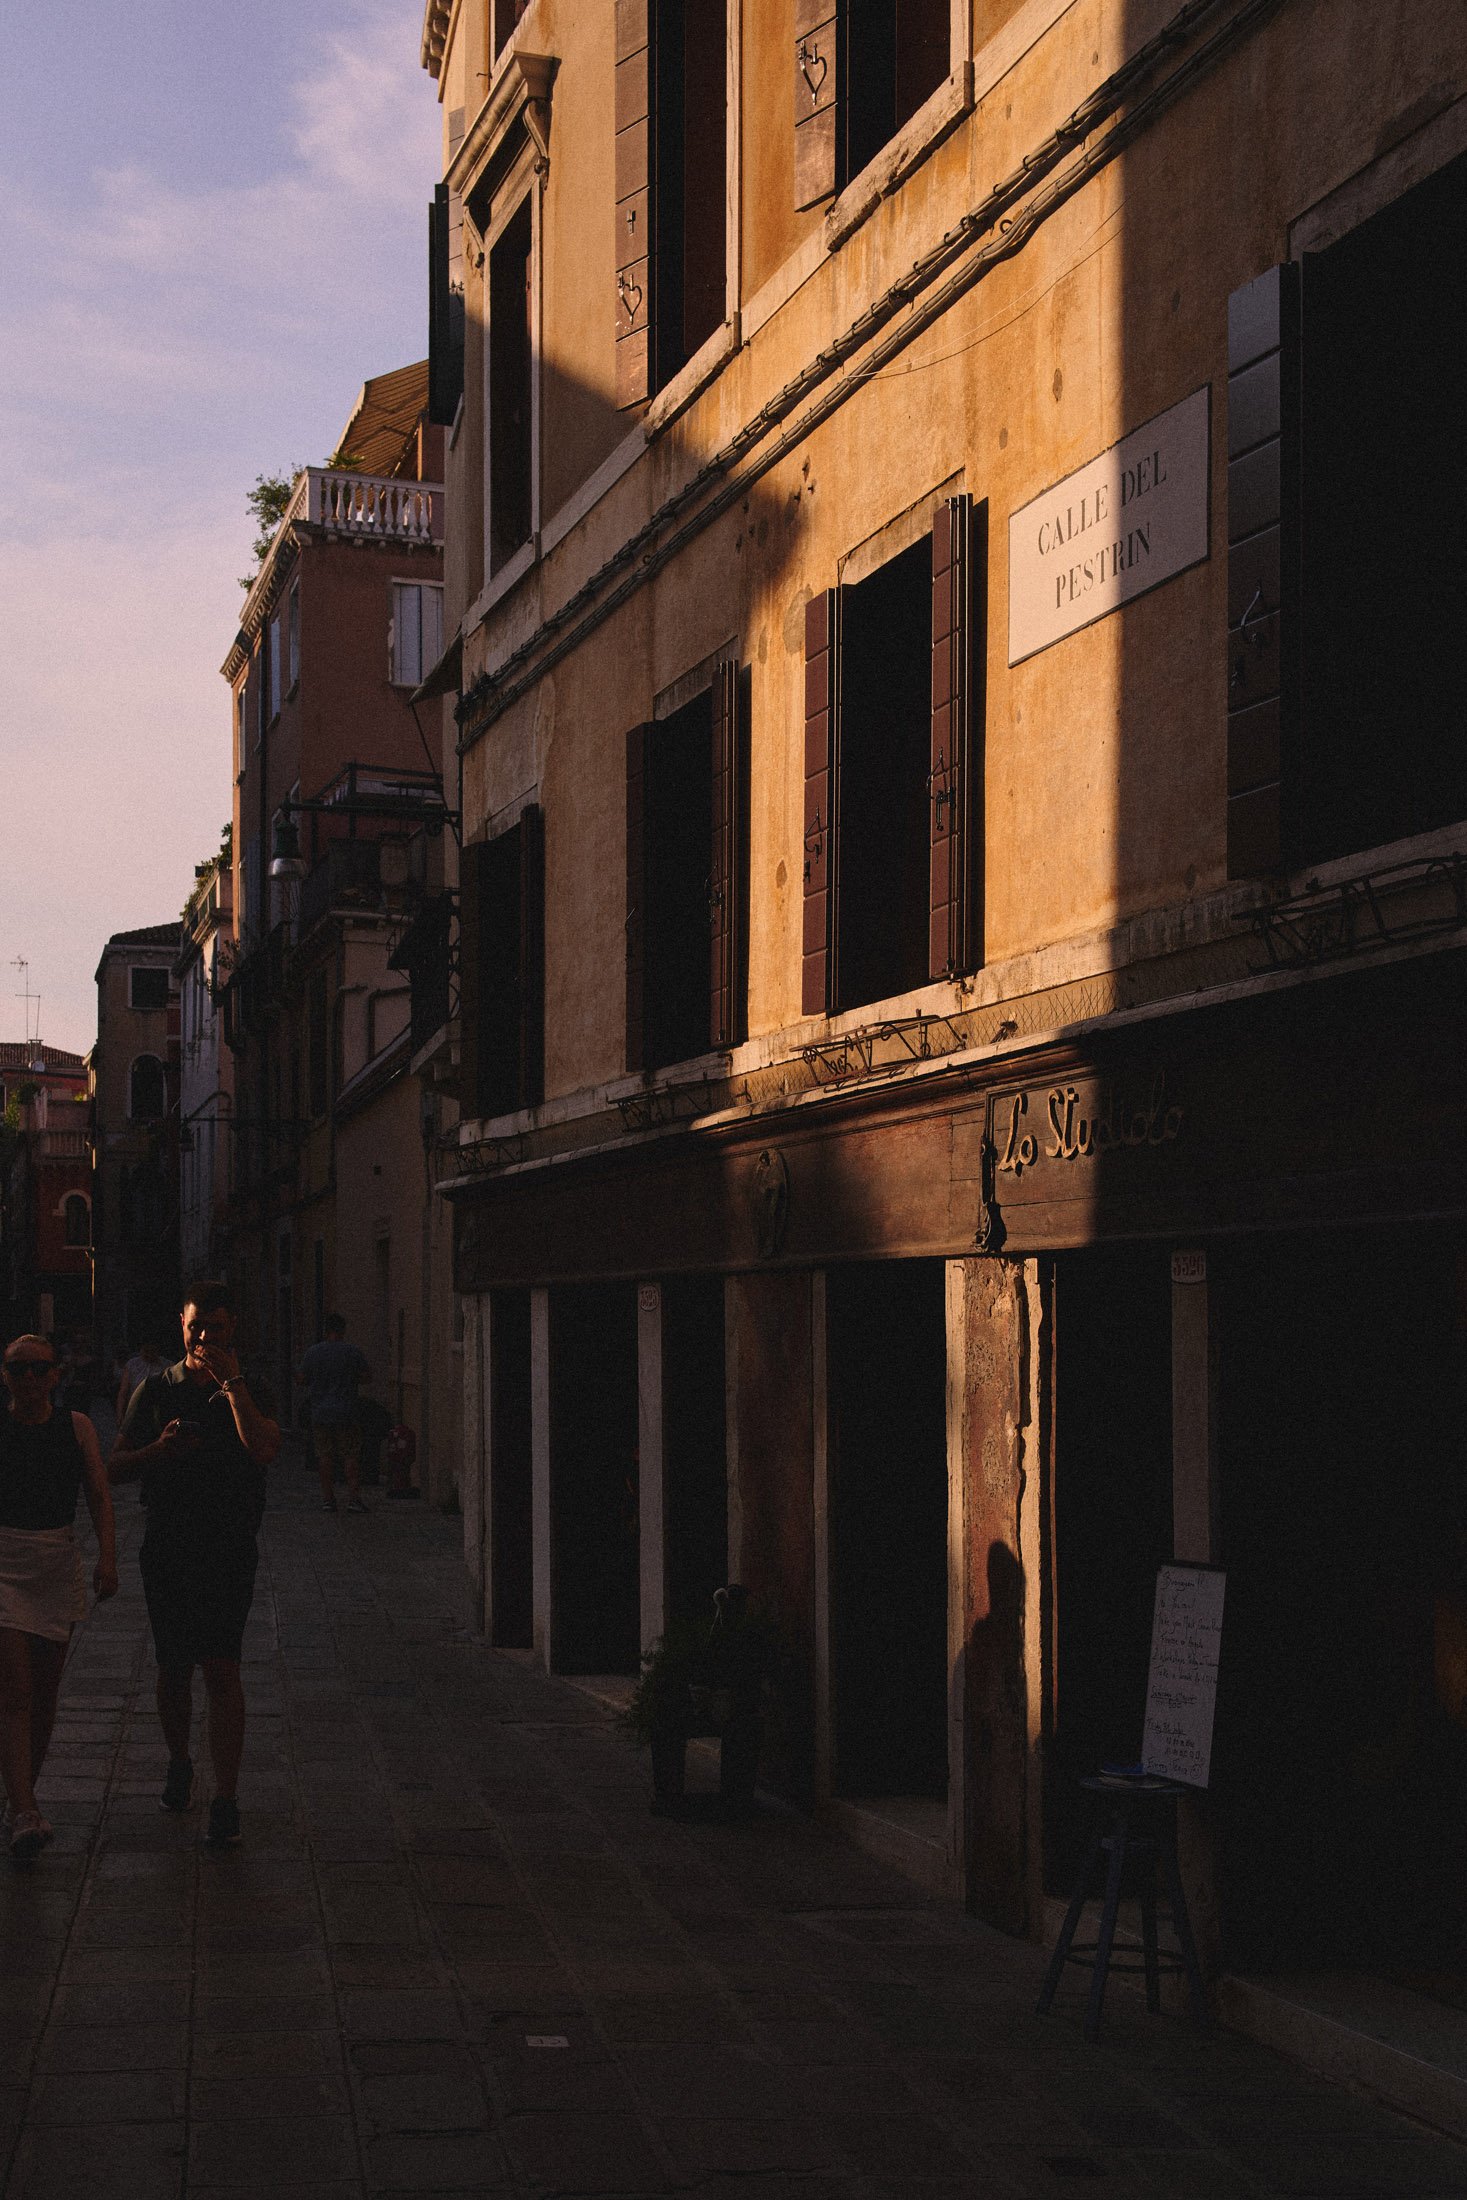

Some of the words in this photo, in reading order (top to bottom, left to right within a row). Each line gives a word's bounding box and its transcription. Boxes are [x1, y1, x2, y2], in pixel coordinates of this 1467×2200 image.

[1038, 485, 1108, 556] CALLE
[1120, 450, 1167, 508] DEL
[1055, 522, 1150, 609] PESTRIN
[998, 1092, 1038, 1177] Lo
